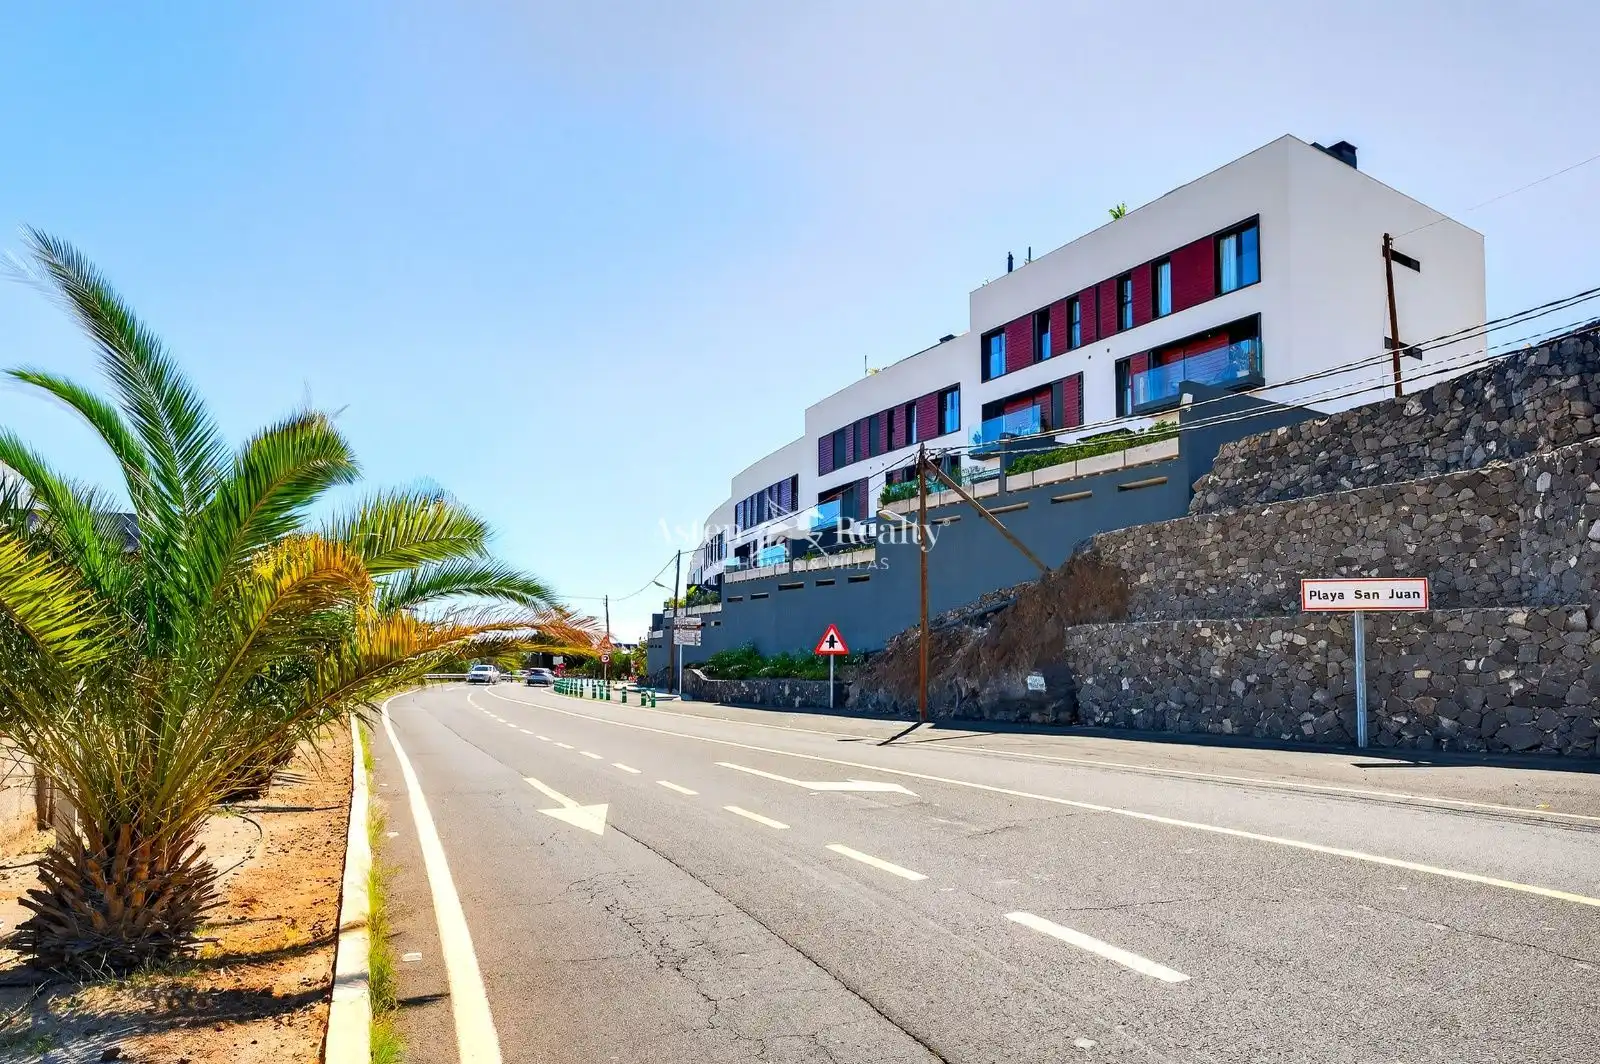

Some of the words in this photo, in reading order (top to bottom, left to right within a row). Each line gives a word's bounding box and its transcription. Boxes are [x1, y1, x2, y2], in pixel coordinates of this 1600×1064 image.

[1309, 590, 1345, 602] Playa
[1354, 589, 1380, 600] San
[1388, 588, 1421, 599] Juan
